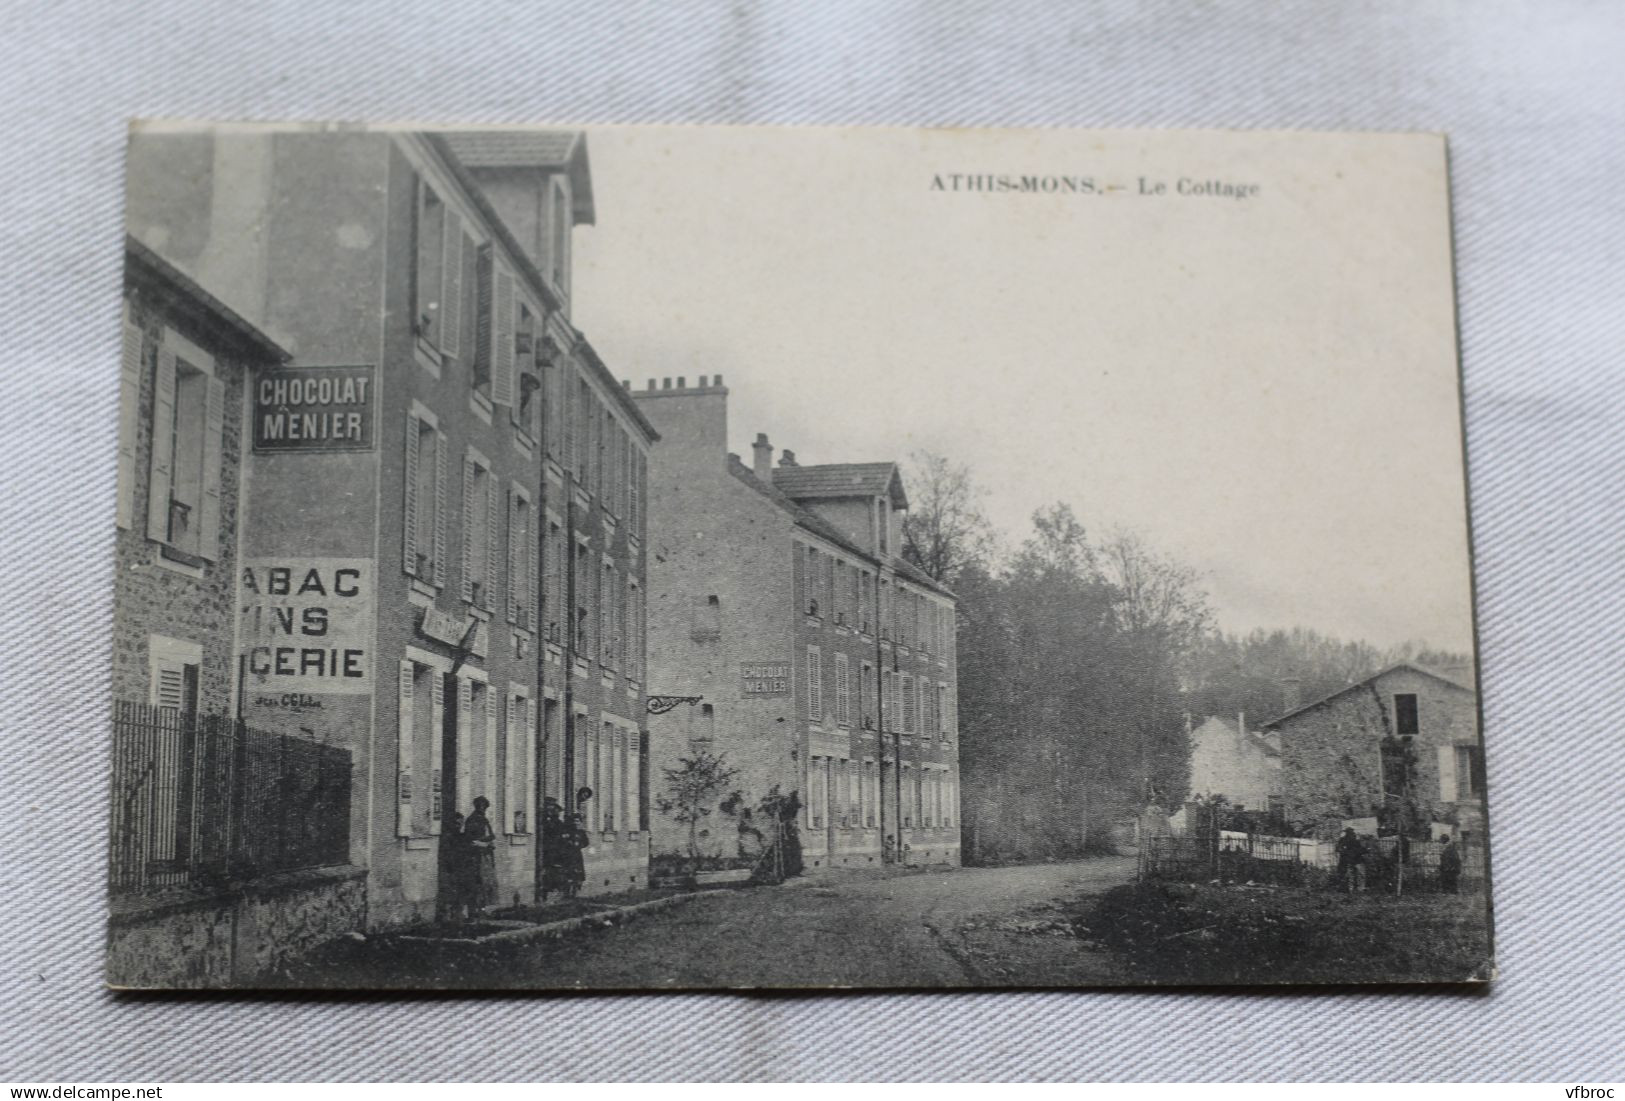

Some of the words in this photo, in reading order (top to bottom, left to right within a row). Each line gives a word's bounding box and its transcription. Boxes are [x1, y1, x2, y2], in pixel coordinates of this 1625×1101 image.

[1137, 177, 1167, 196] Le
[1176, 177, 1262, 200] Cottage
[260, 377, 368, 405] CHOCOLAT
[264, 412, 361, 441] MENIER
